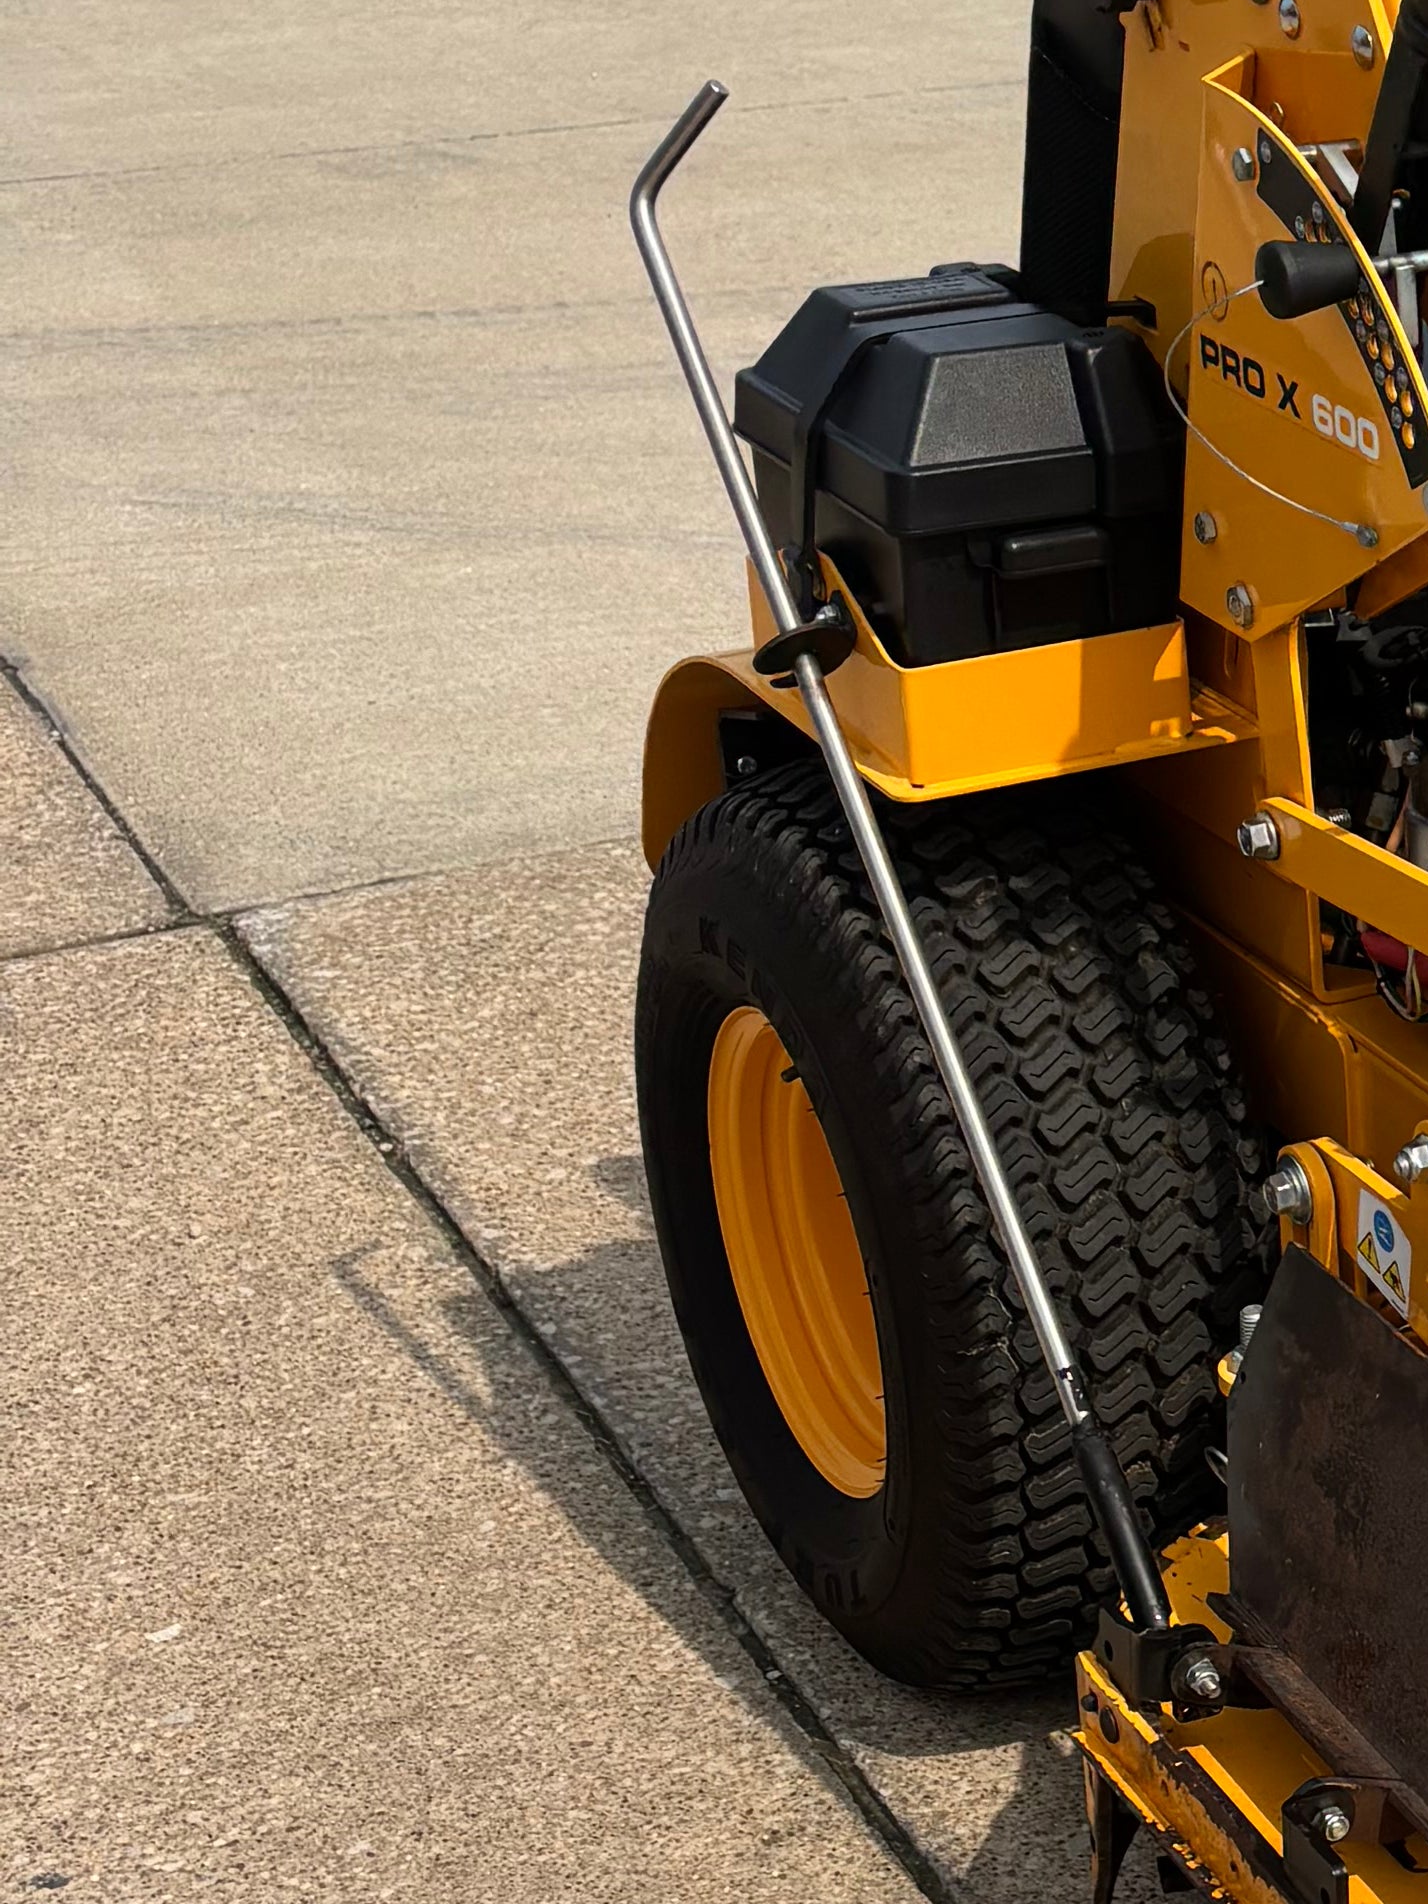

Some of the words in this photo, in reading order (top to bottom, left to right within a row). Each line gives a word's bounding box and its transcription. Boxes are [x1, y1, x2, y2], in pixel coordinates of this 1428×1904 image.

[1199, 332, 1266, 399] PRO
[1276, 372, 1302, 421] X
[1311, 393, 1380, 461] 600
